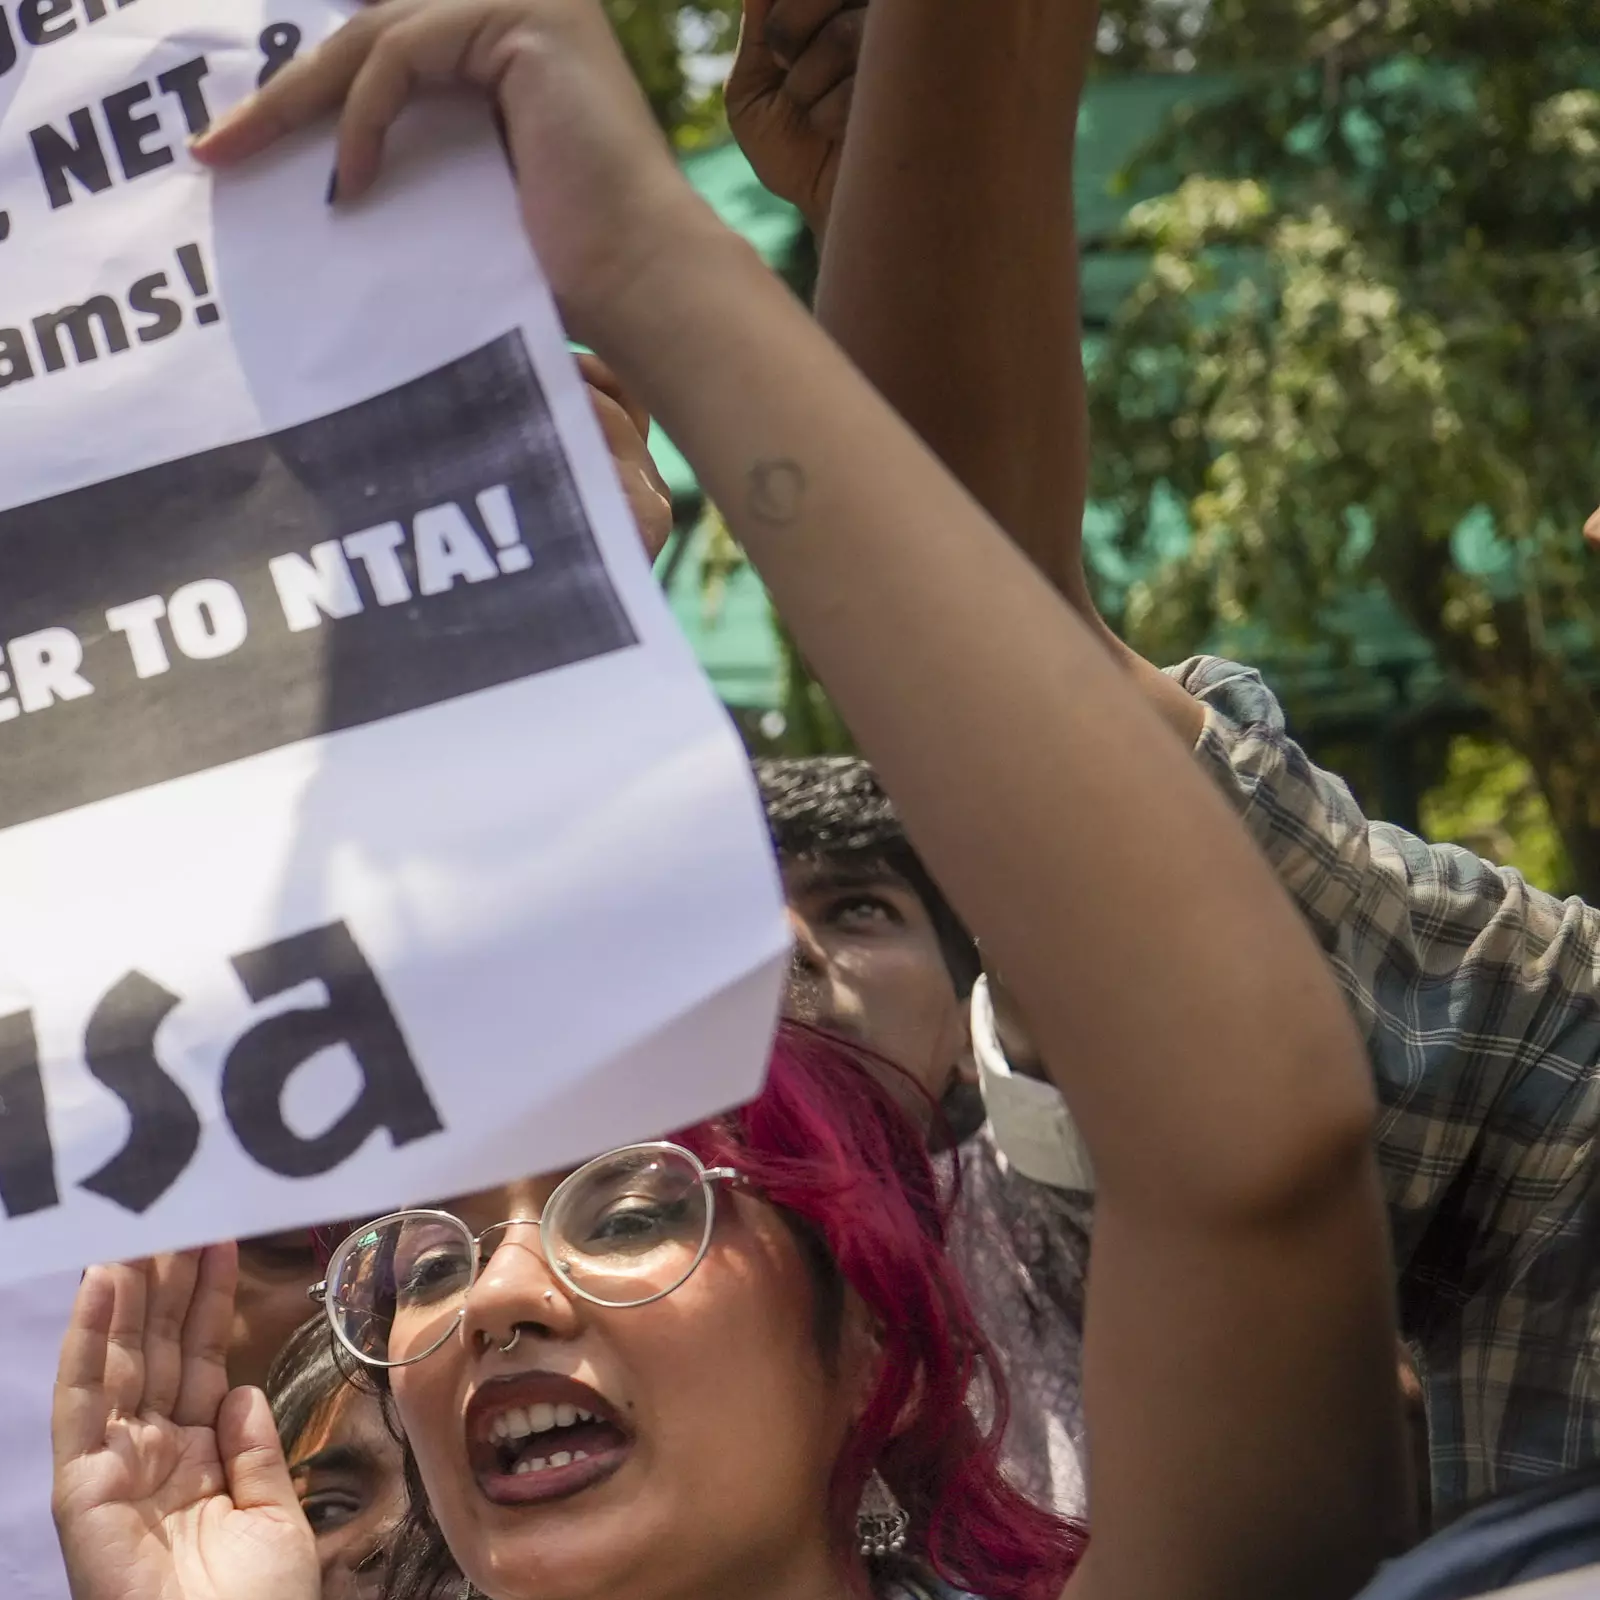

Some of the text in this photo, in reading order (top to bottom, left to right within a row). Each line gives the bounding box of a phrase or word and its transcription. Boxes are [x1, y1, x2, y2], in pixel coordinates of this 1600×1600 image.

[29, 56, 212, 210] NET
[106, 575, 250, 669] TO
[269, 484, 535, 634] NTA!
